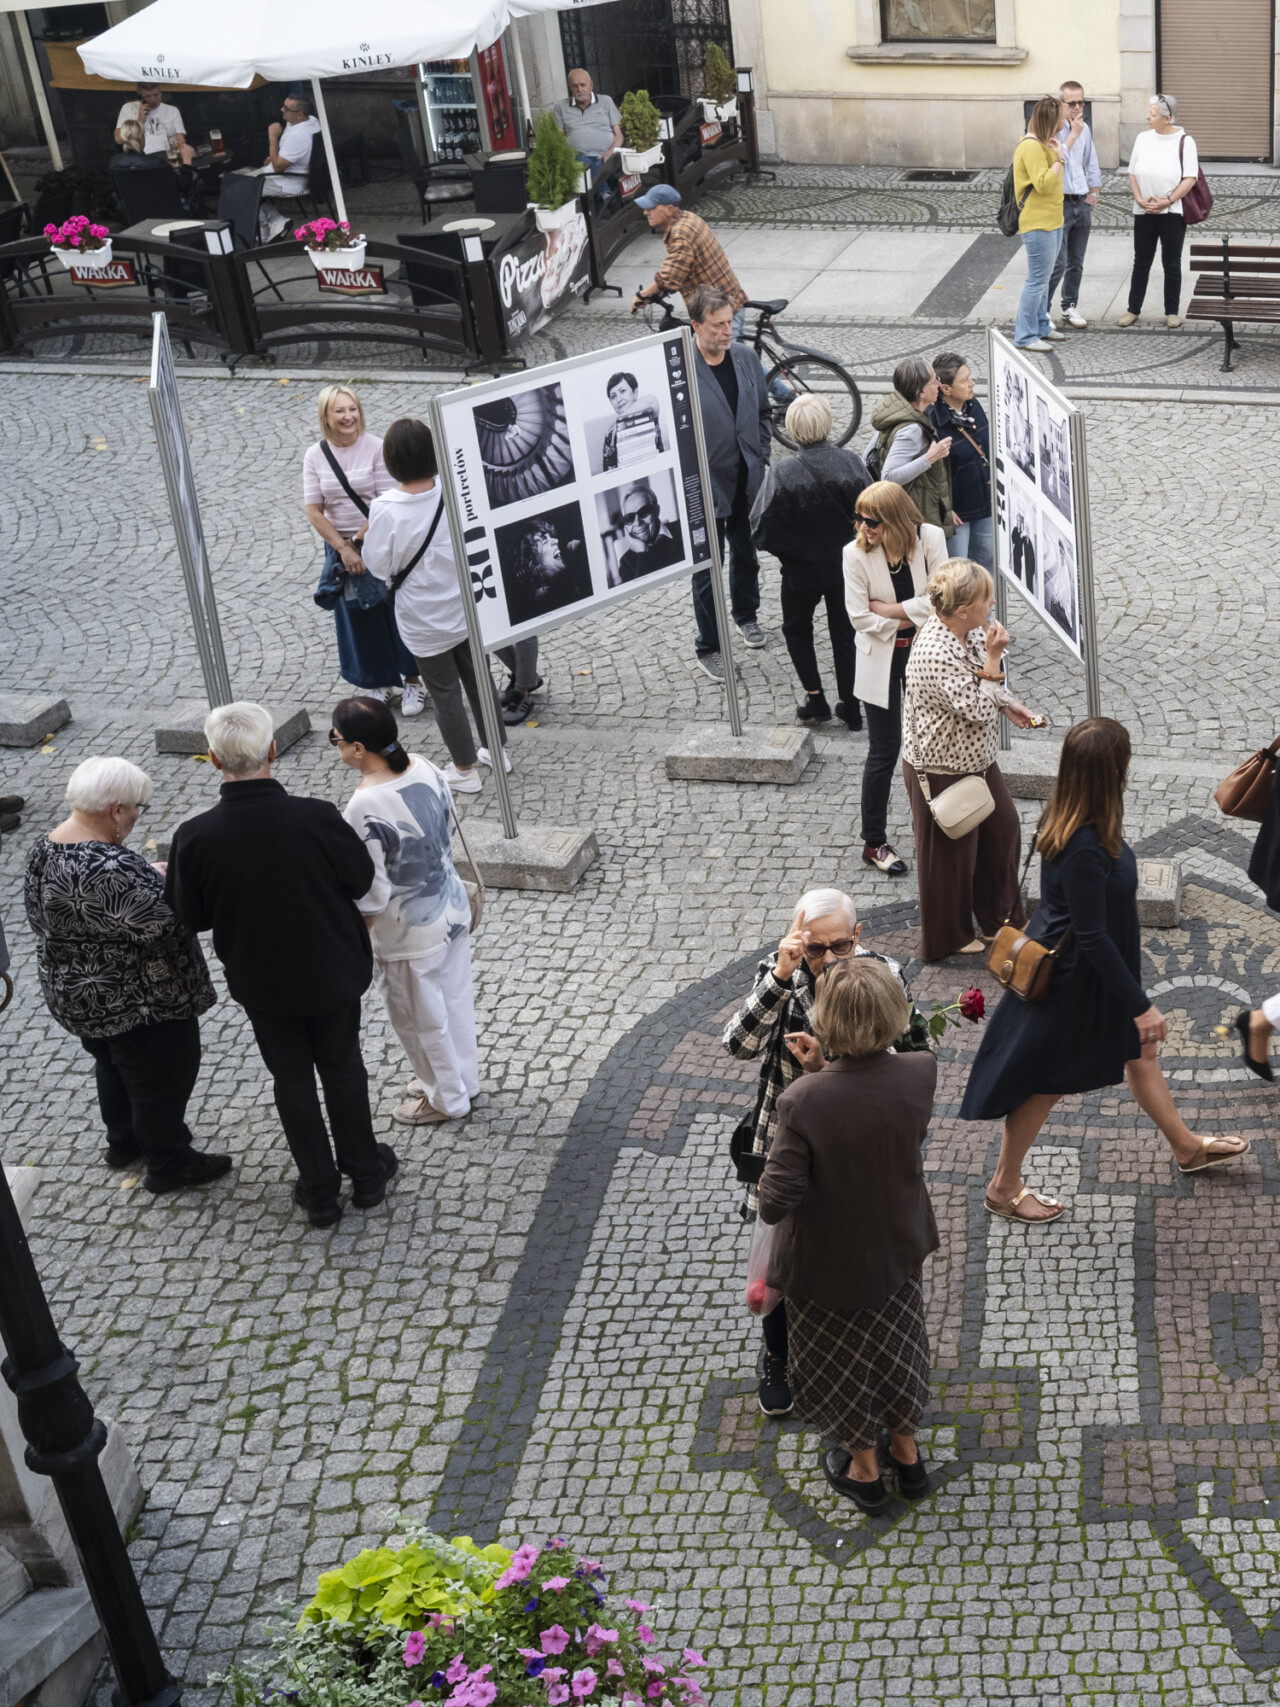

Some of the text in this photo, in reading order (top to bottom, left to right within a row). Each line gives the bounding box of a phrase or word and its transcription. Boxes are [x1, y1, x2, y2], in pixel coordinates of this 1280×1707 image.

[342, 54, 392, 70] KINLEY
[141, 66, 181, 79] KINLEY
[73, 264, 129, 280] WARKA
[321, 270, 377, 288] WARKA
[500, 250, 546, 308] Pizza
[454, 447, 478, 522] portretów
